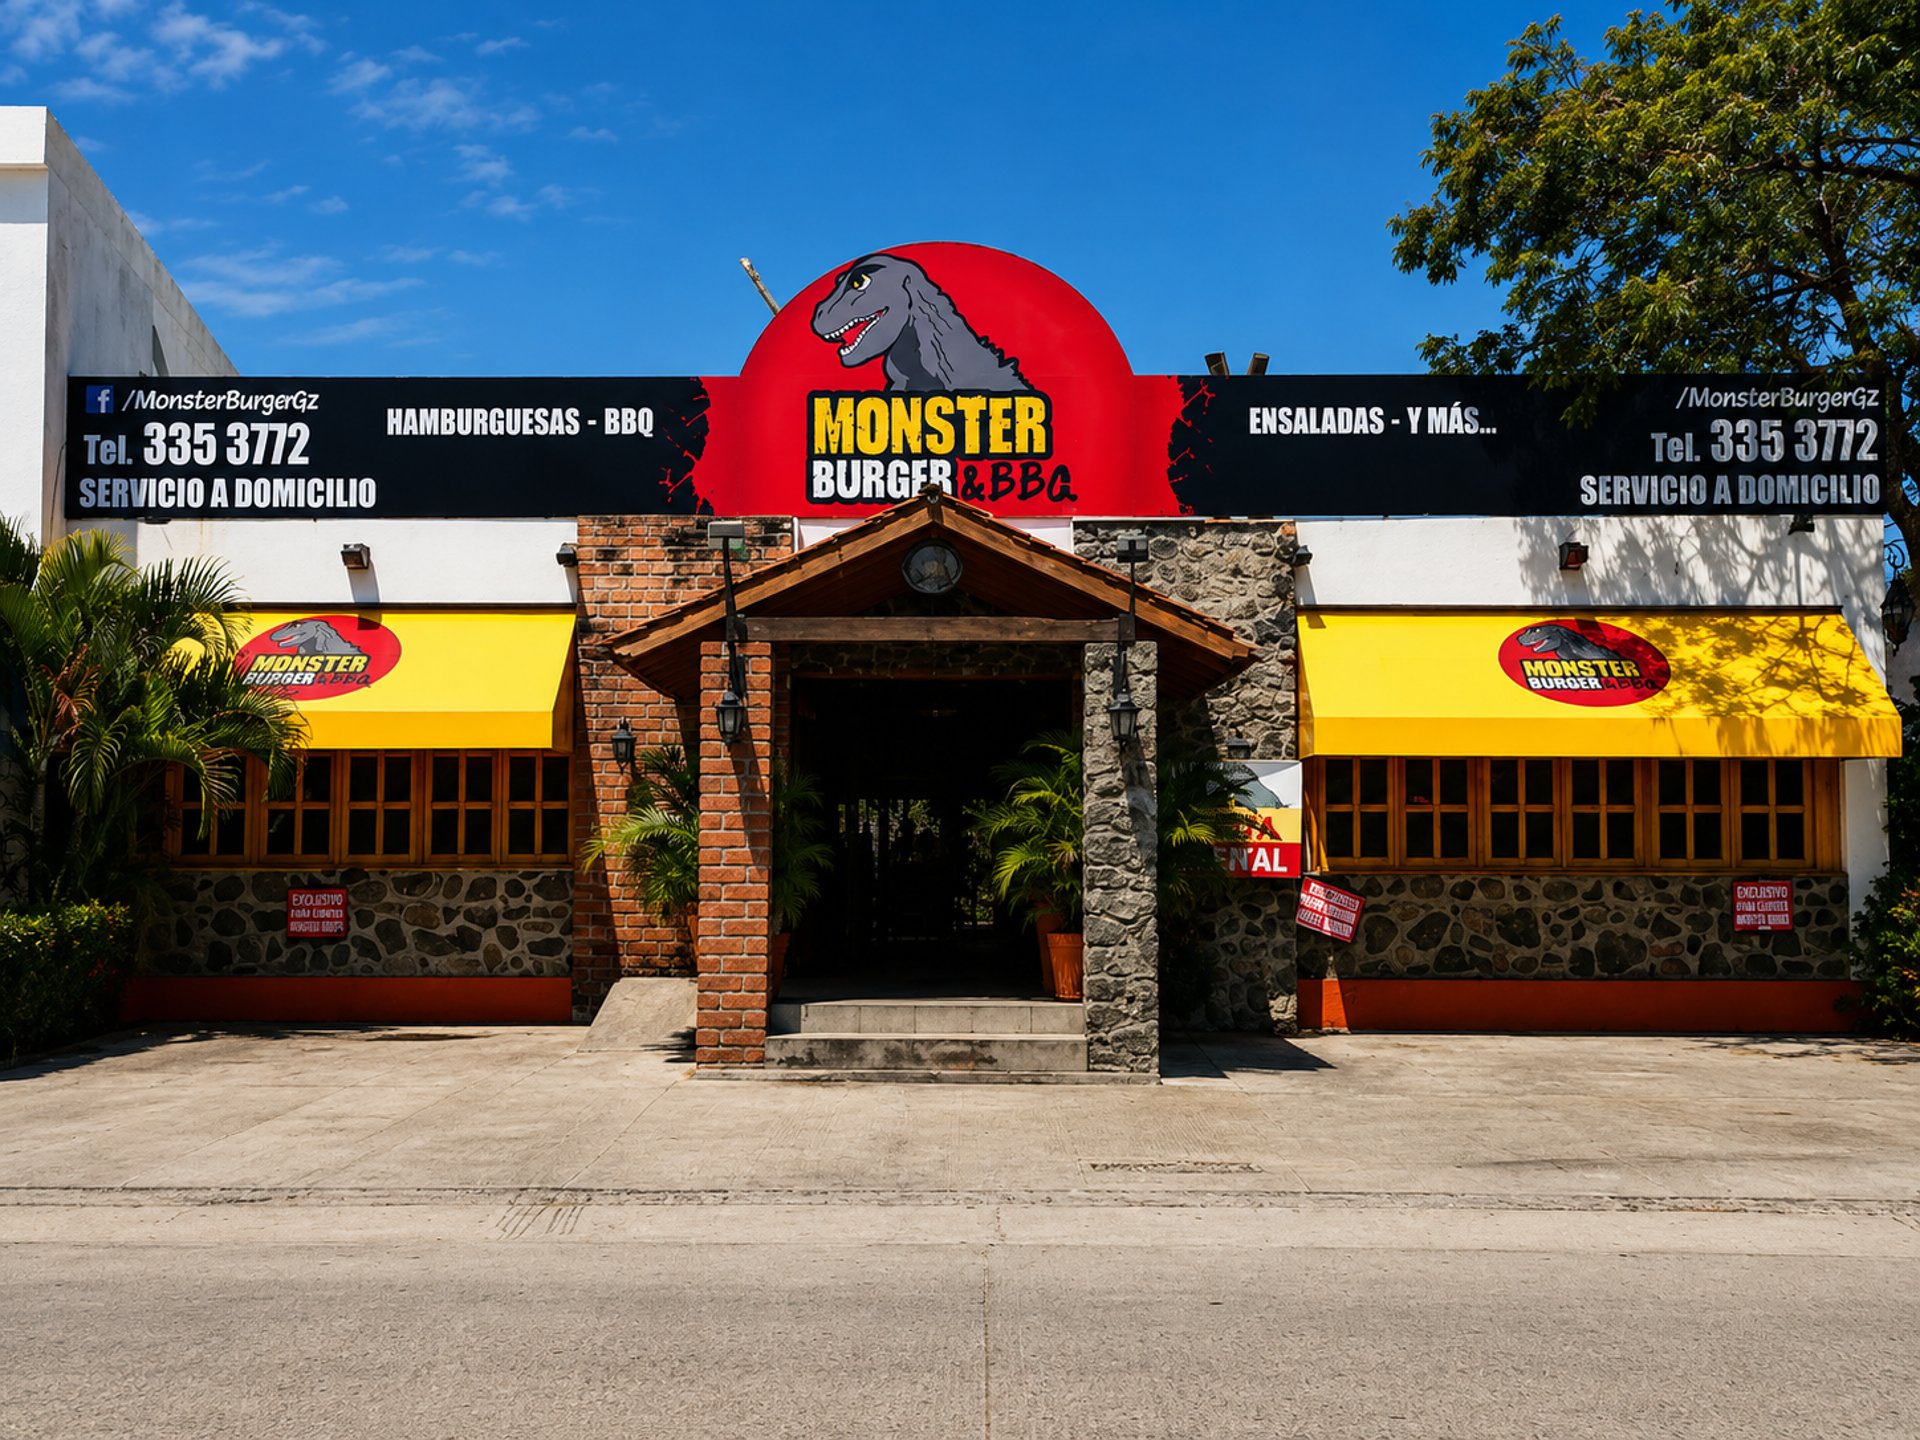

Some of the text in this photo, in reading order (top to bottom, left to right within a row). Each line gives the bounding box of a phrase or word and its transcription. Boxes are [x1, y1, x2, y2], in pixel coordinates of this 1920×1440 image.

[121, 389, 320, 416] /MonsterBurgerGz
[1675, 386, 1880, 414] /MonsterBurgerGz
[386, 407, 581, 436] HAMBURGUESAS
[604, 406, 654, 438] BBQ
[813, 396, 1047, 456] MONSTER
[1249, 406, 1385, 435] ENSALADAS
[1406, 406, 1423, 435] Y
[1427, 400, 1497, 435] MÁS...
[83, 421, 311, 466] Tel. 335 3772
[1650, 418, 1879, 463] Tel. 335 3772
[79, 477, 377, 508] SERVICIO A DOMICILIO
[812, 459, 954, 499] BURGER
[1579, 474, 1881, 506] SERVICIO A DOMICILIO
[249, 655, 369, 672] MONSTER
[1522, 660, 1640, 677] MONSTER
[1528, 677, 1603, 690] BURGER
